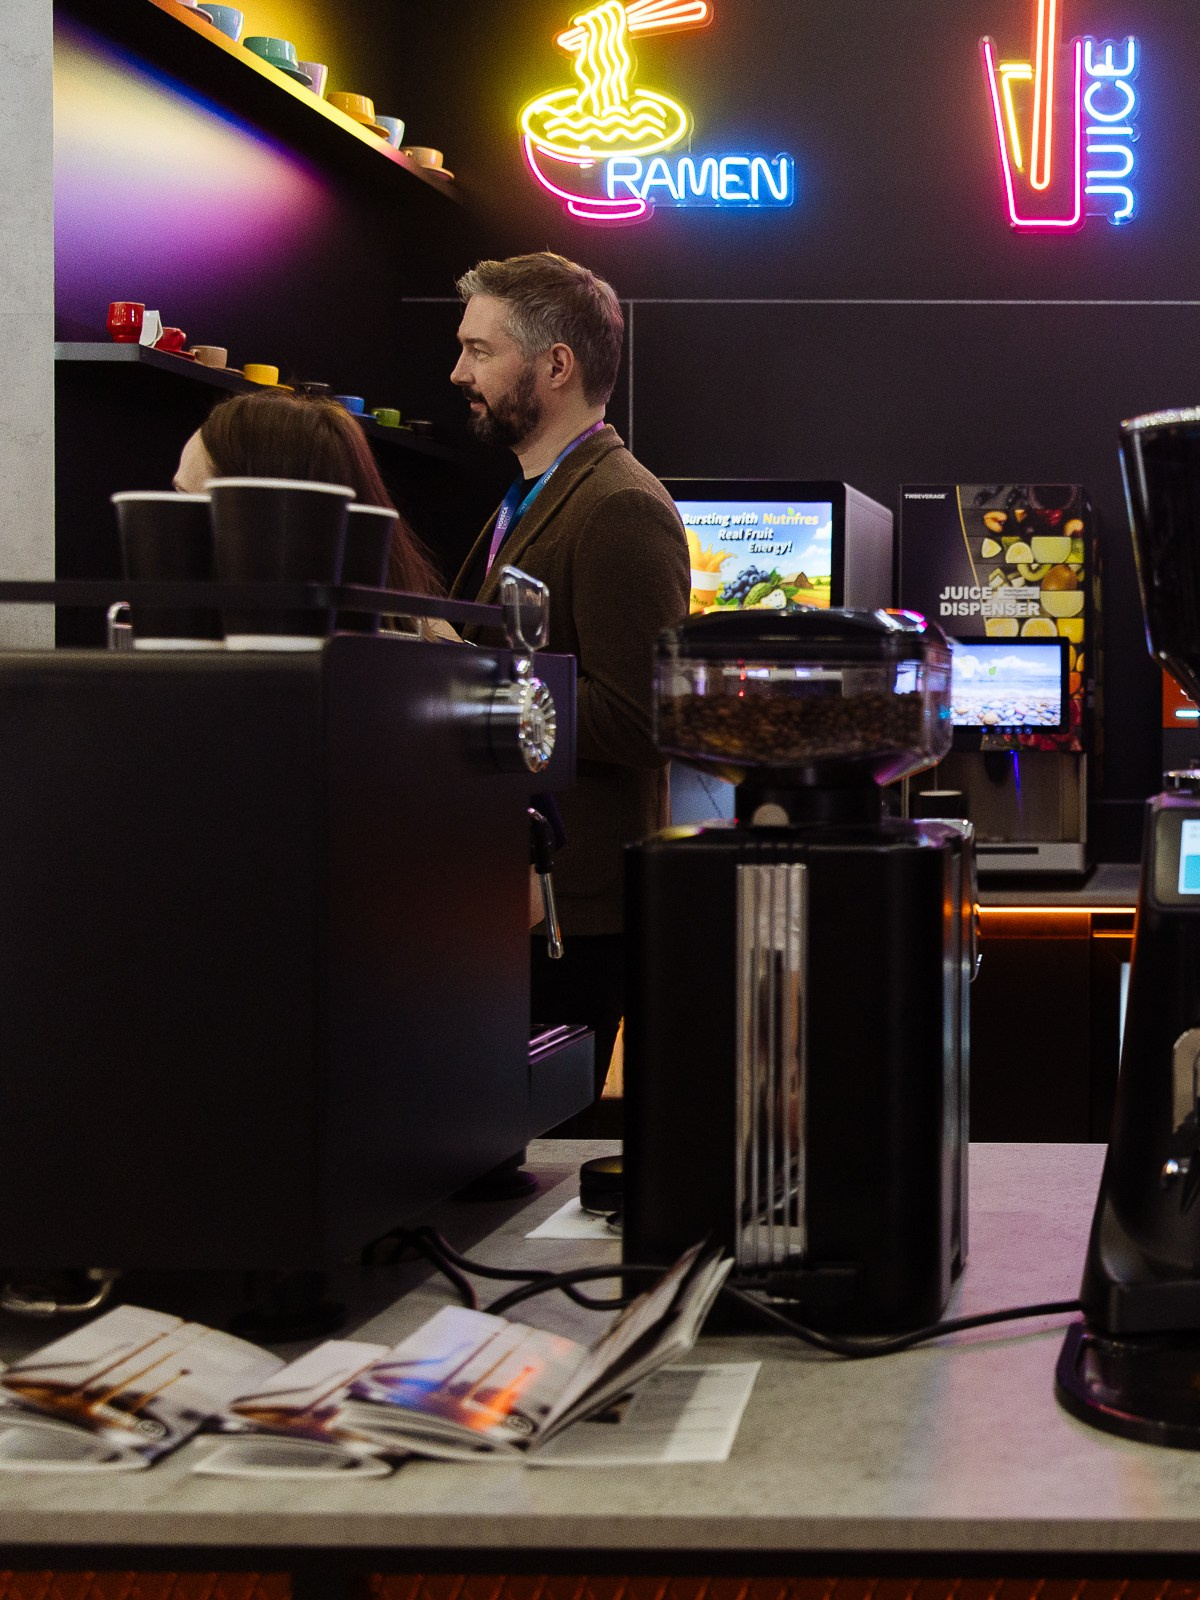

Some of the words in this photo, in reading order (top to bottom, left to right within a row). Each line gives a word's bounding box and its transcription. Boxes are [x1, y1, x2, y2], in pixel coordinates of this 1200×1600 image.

[1084, 38, 1135, 219] JUICE
[606, 155, 789, 201] RAMEN
[497, 506, 509, 529] HORECA
[683, 512, 730, 527] Bursting
[732, 512, 758, 526] with
[762, 513, 819, 525] Nutrifres
[718, 529, 744, 541] Real
[745, 528, 774, 540] Fruit
[749, 541, 793, 555] Energy!
[939, 586, 993, 600] JUICE
[940, 602, 1040, 616] DISPENSER
